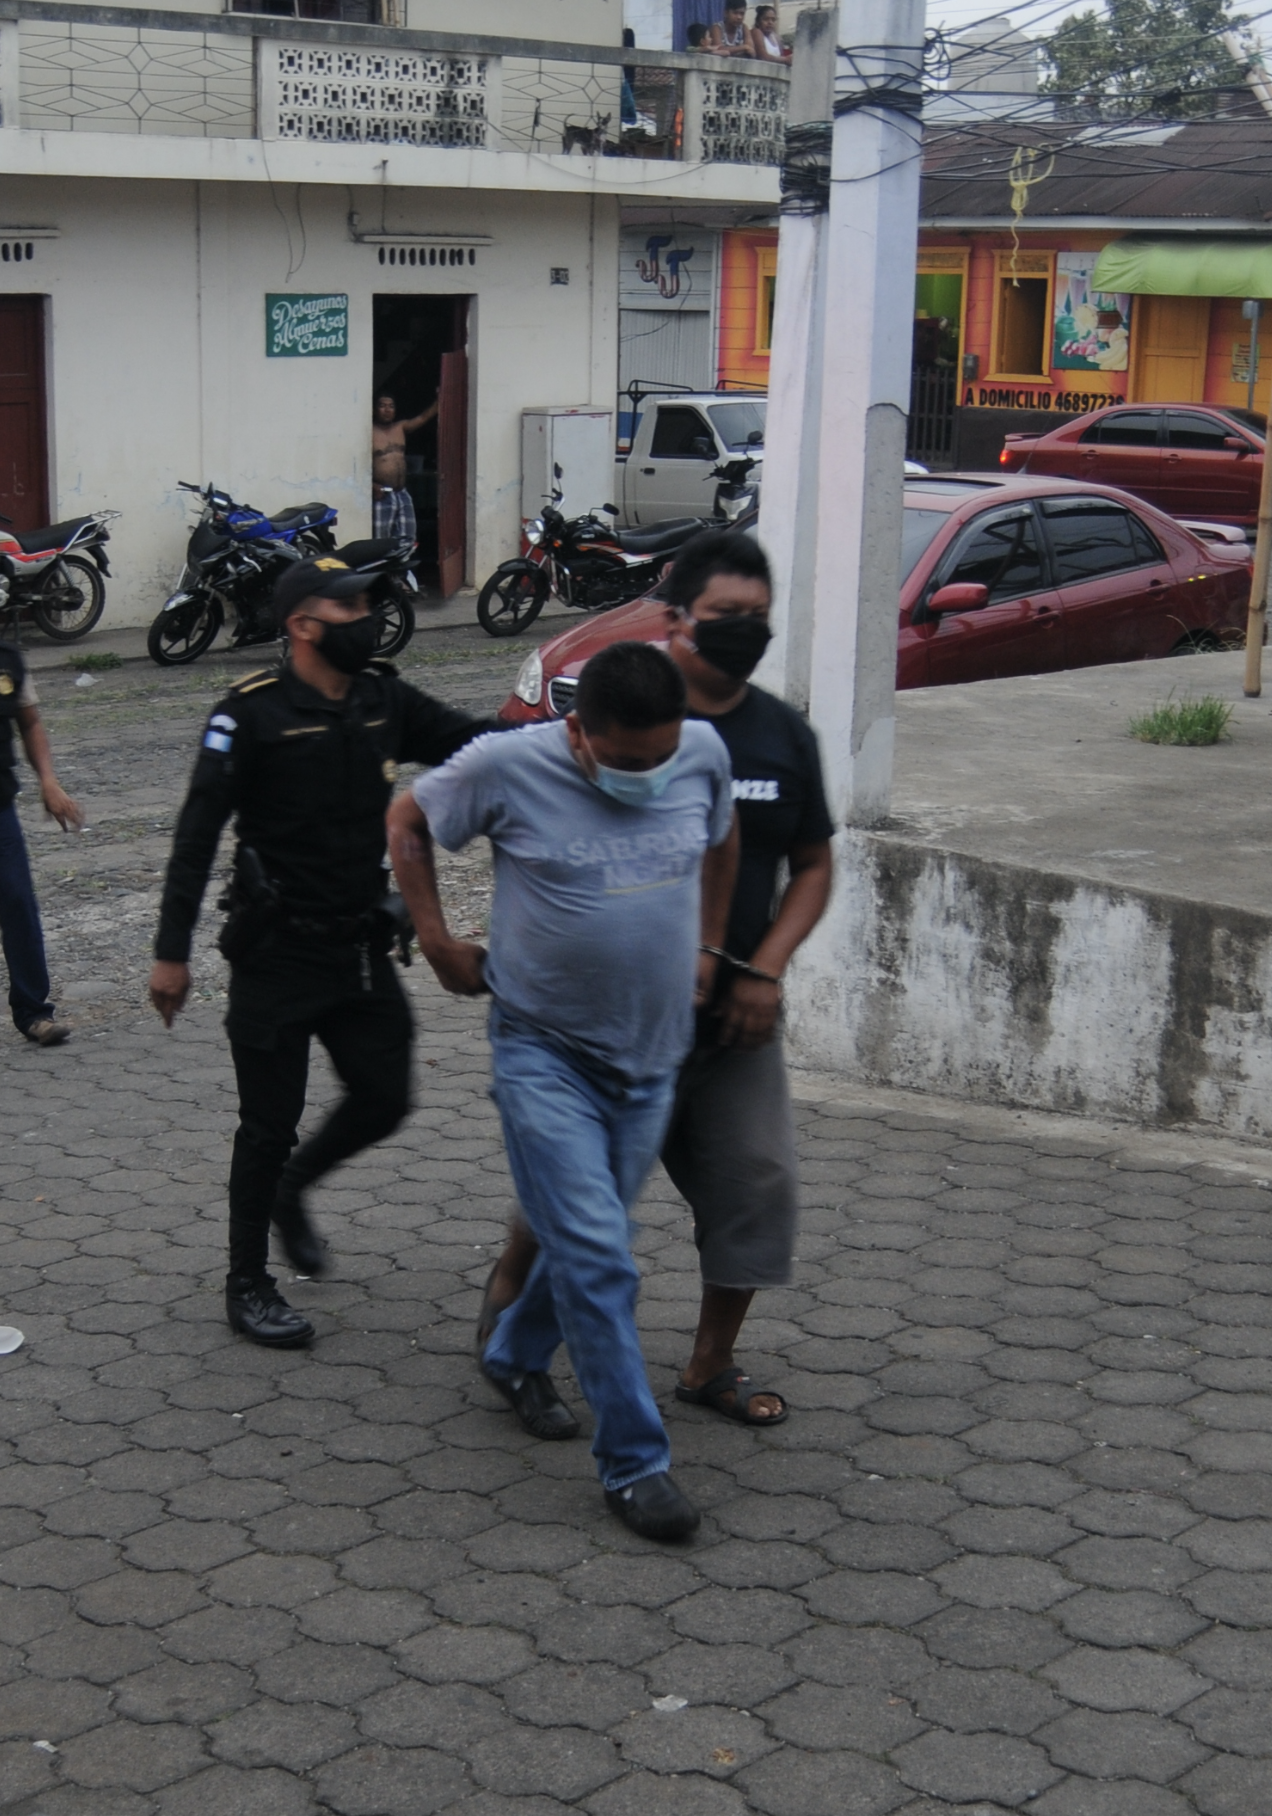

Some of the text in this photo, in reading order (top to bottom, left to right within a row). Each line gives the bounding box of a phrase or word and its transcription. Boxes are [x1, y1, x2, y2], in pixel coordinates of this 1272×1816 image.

[271, 296, 347, 331] Desayunos
[273, 313, 346, 353] Almuerzos
[297, 330, 345, 353] Cenas
[965, 387, 975, 406] A
[979, 388, 1051, 410] DOMICILIO
